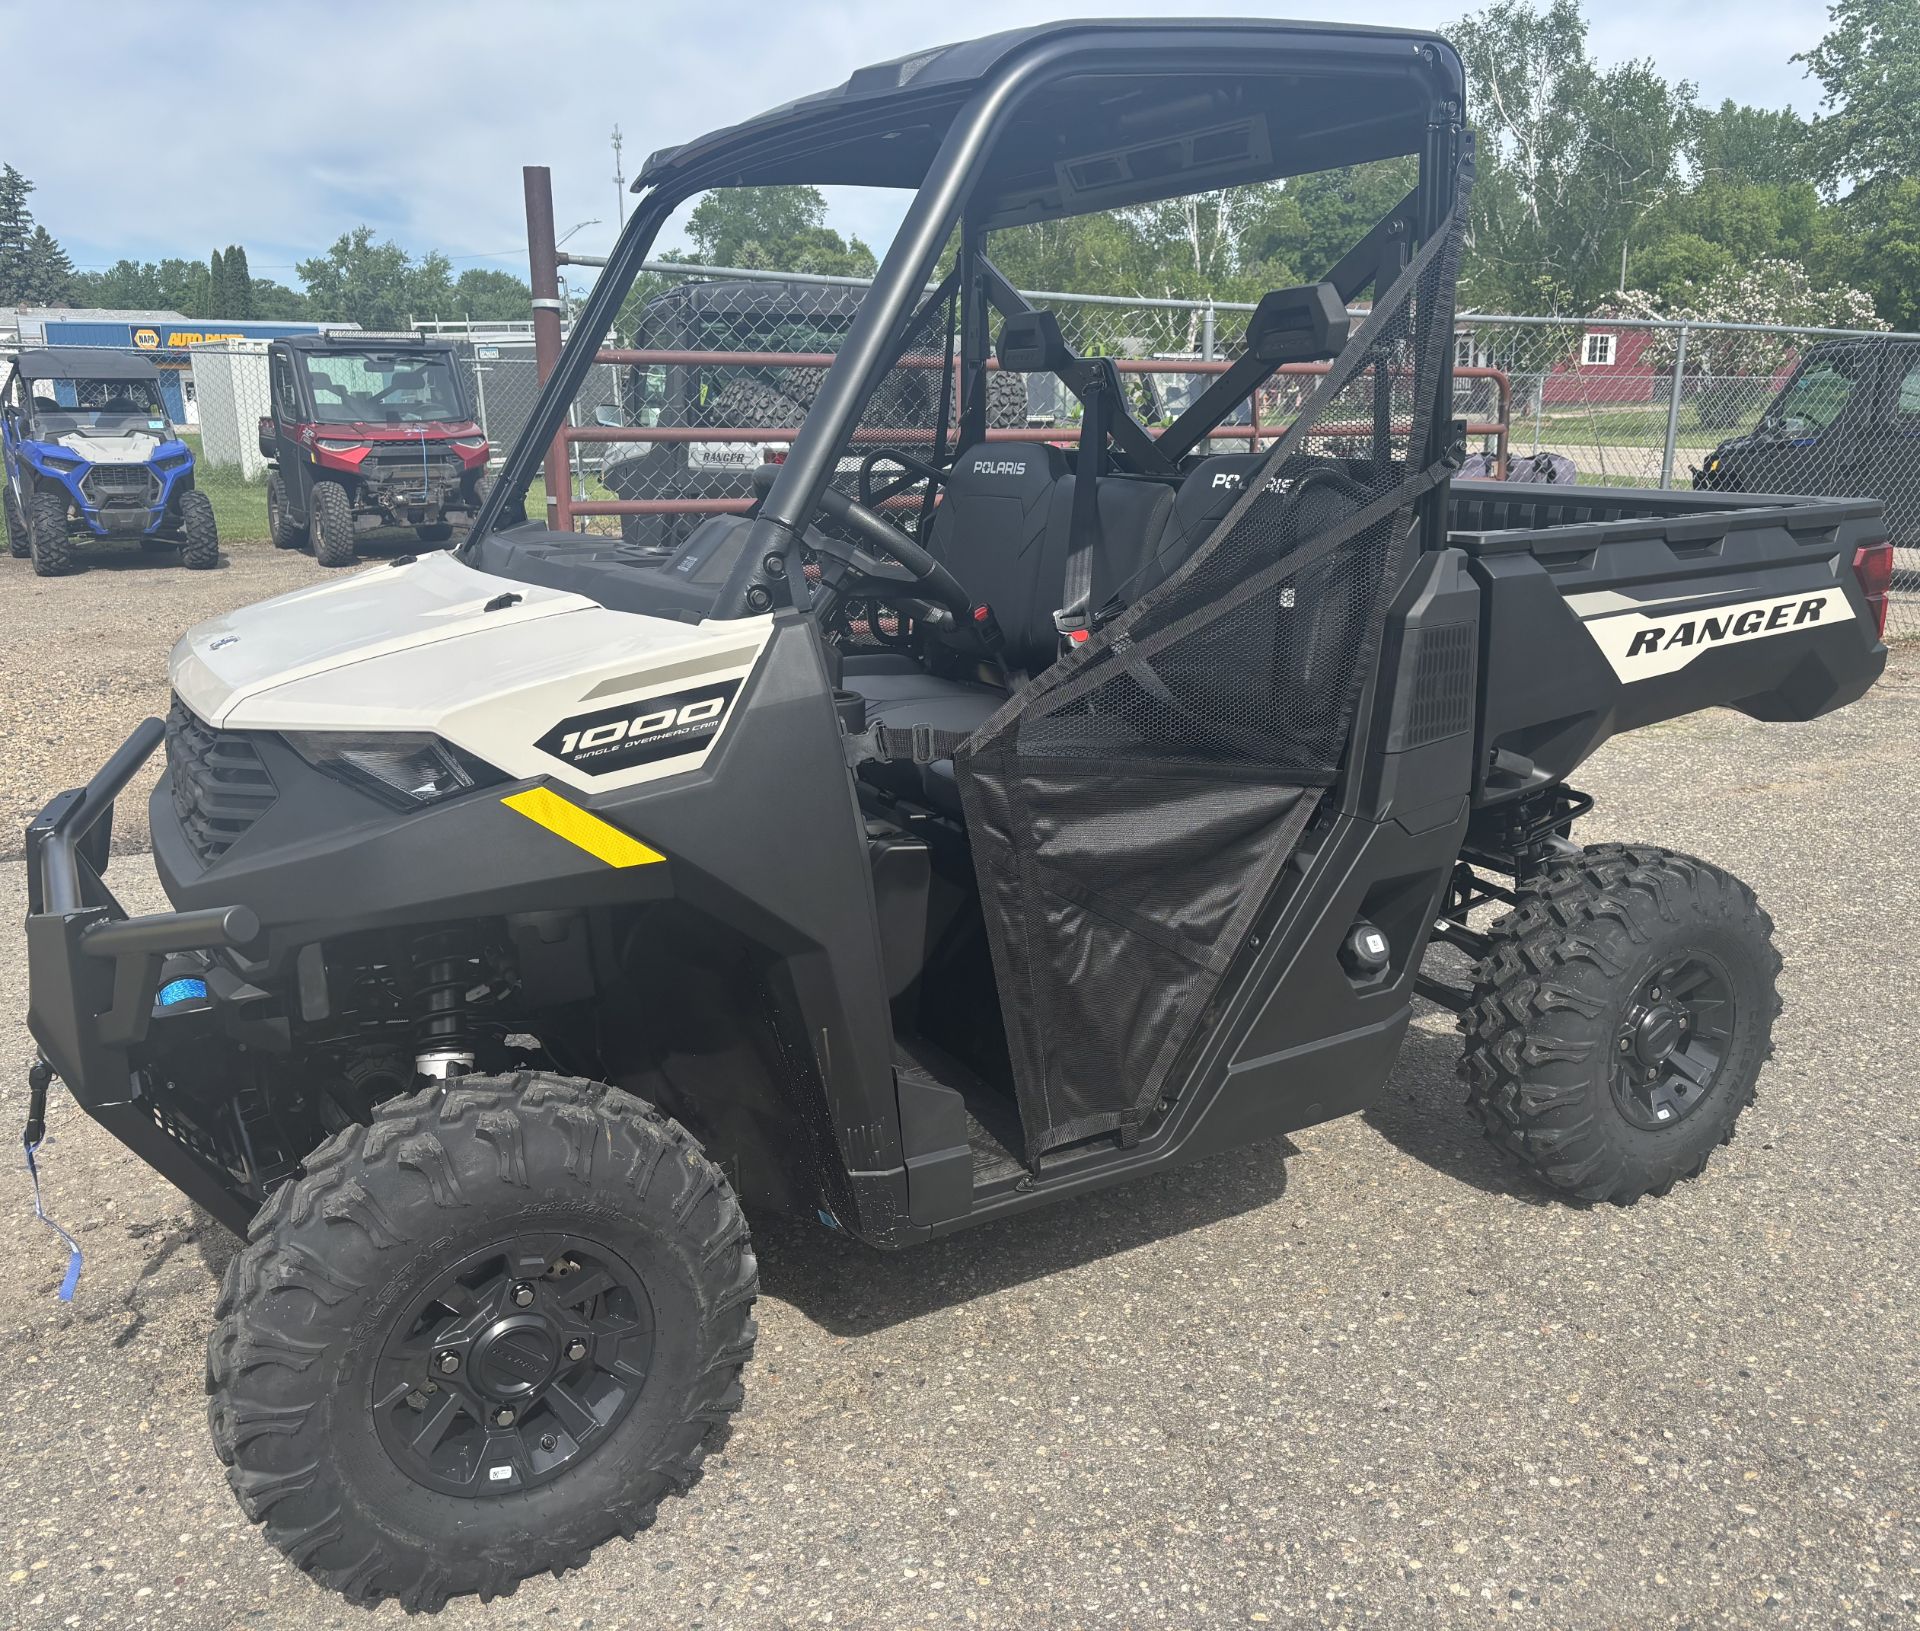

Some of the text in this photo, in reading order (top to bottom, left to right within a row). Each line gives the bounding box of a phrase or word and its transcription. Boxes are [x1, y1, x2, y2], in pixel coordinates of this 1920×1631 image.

[138, 335, 155, 344] NAPA
[167, 332, 203, 347] AUTO
[703, 452, 745, 463] RANGER
[973, 461, 1027, 475] POLARIS
[1625, 597, 1827, 658] RANGER
[560, 696, 725, 755] 1000
[573, 720, 719, 761] SINGLE OVERHEAD CAM
